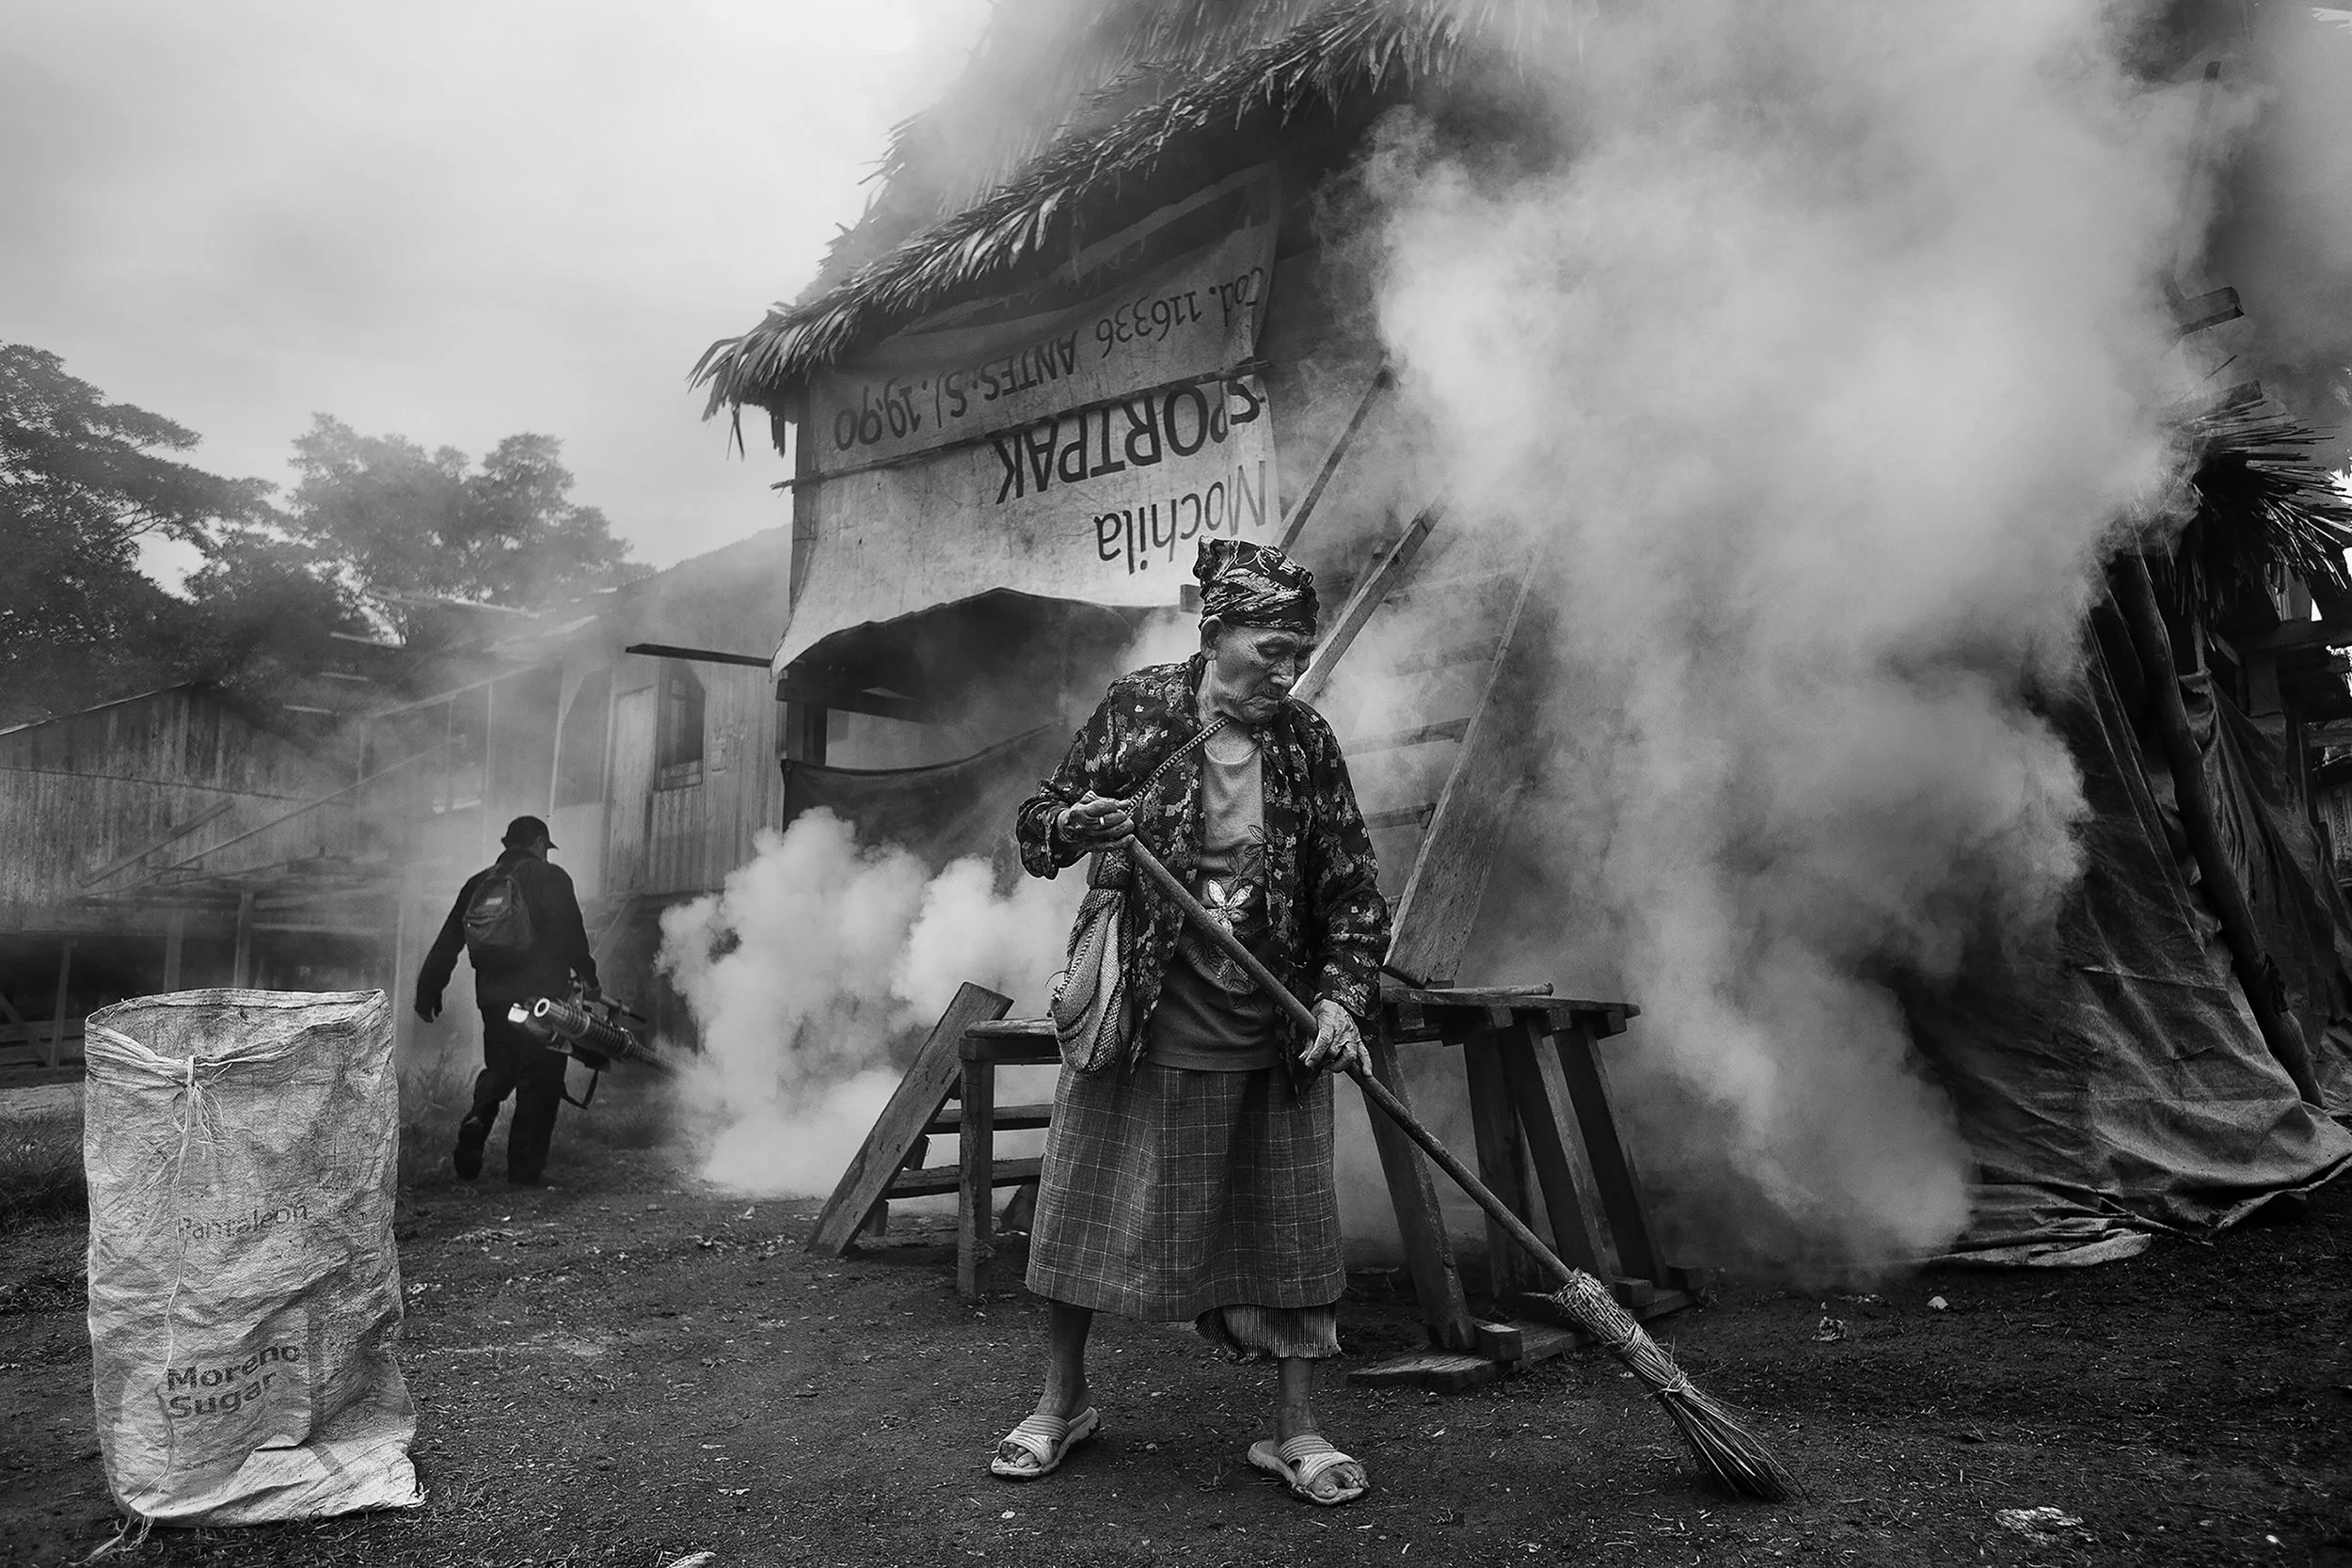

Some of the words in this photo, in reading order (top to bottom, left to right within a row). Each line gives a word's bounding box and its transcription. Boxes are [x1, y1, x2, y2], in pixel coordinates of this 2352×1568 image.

[1096, 296, 1202, 358] 116336
[995, 380, 1259, 505] SPORTPAK
[1094, 459, 1267, 575] Mochila
[167, 1345, 301, 1391] Moreno
[167, 1372, 278, 1418] Sugar
